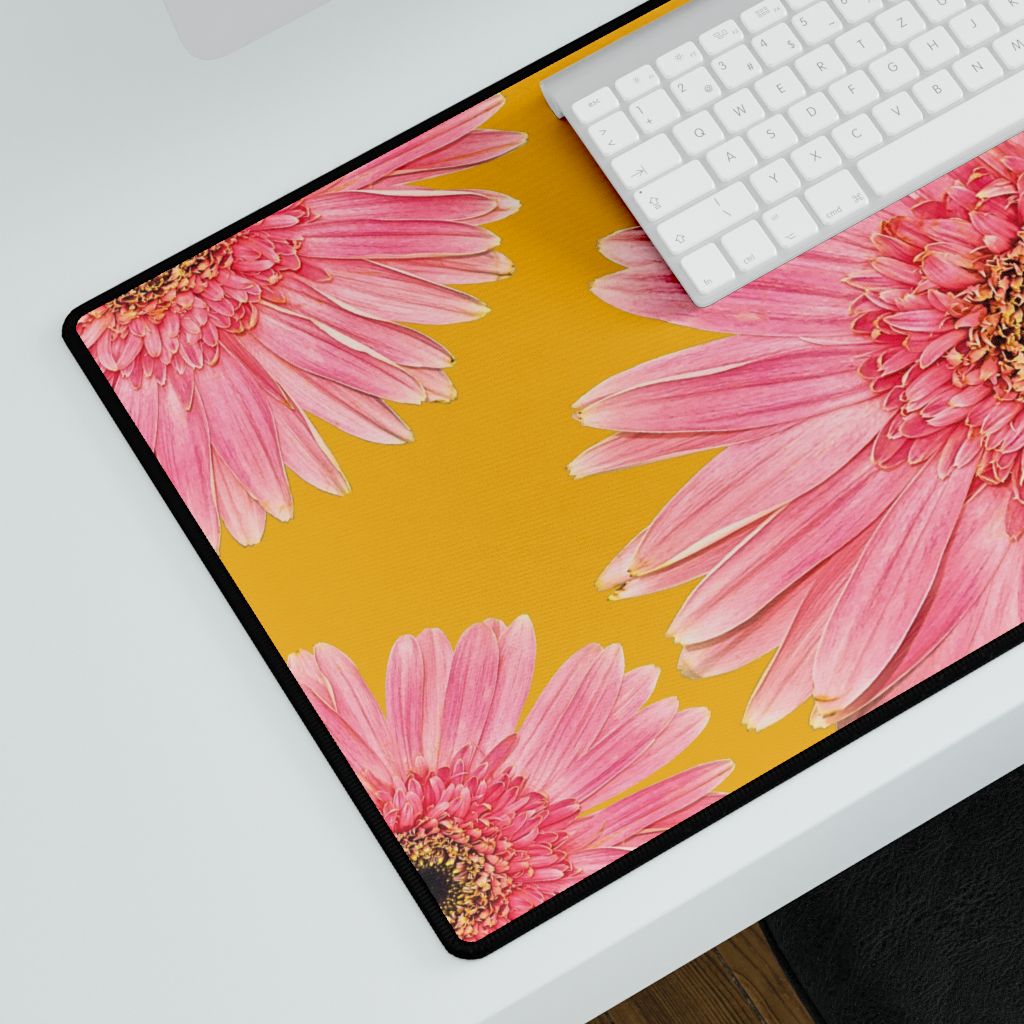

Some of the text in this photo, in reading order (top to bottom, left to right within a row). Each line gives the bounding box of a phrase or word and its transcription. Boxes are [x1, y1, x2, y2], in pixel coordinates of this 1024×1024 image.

[799, 16, 808, 27] 5
[896, 16, 908, 29] Z
[969, 17, 977, 29] J
[760, 38, 768, 48] 4
[855, 38, 866, 49] T
[926, 39, 939, 51] H
[1011, 39, 1024, 52] M
[717, 60, 728, 71] 3
[816, 61, 827, 72] R
[887, 61, 899, 73] G
[971, 60, 985, 73] N
[677, 82, 687, 94] 2
[775, 82, 787, 94] E
[847, 83, 856, 95] F
[930, 84, 943, 95] B
[732, 103, 747, 117] W
[805, 106, 817, 118] D
[890, 105, 901, 116] V
[693, 127, 707, 138] Q
[765, 128, 776, 140] S
[851, 127, 863, 139] C
[726, 151, 737, 163] A
[809, 149, 822, 162] X
[768, 172, 779, 184] Y
